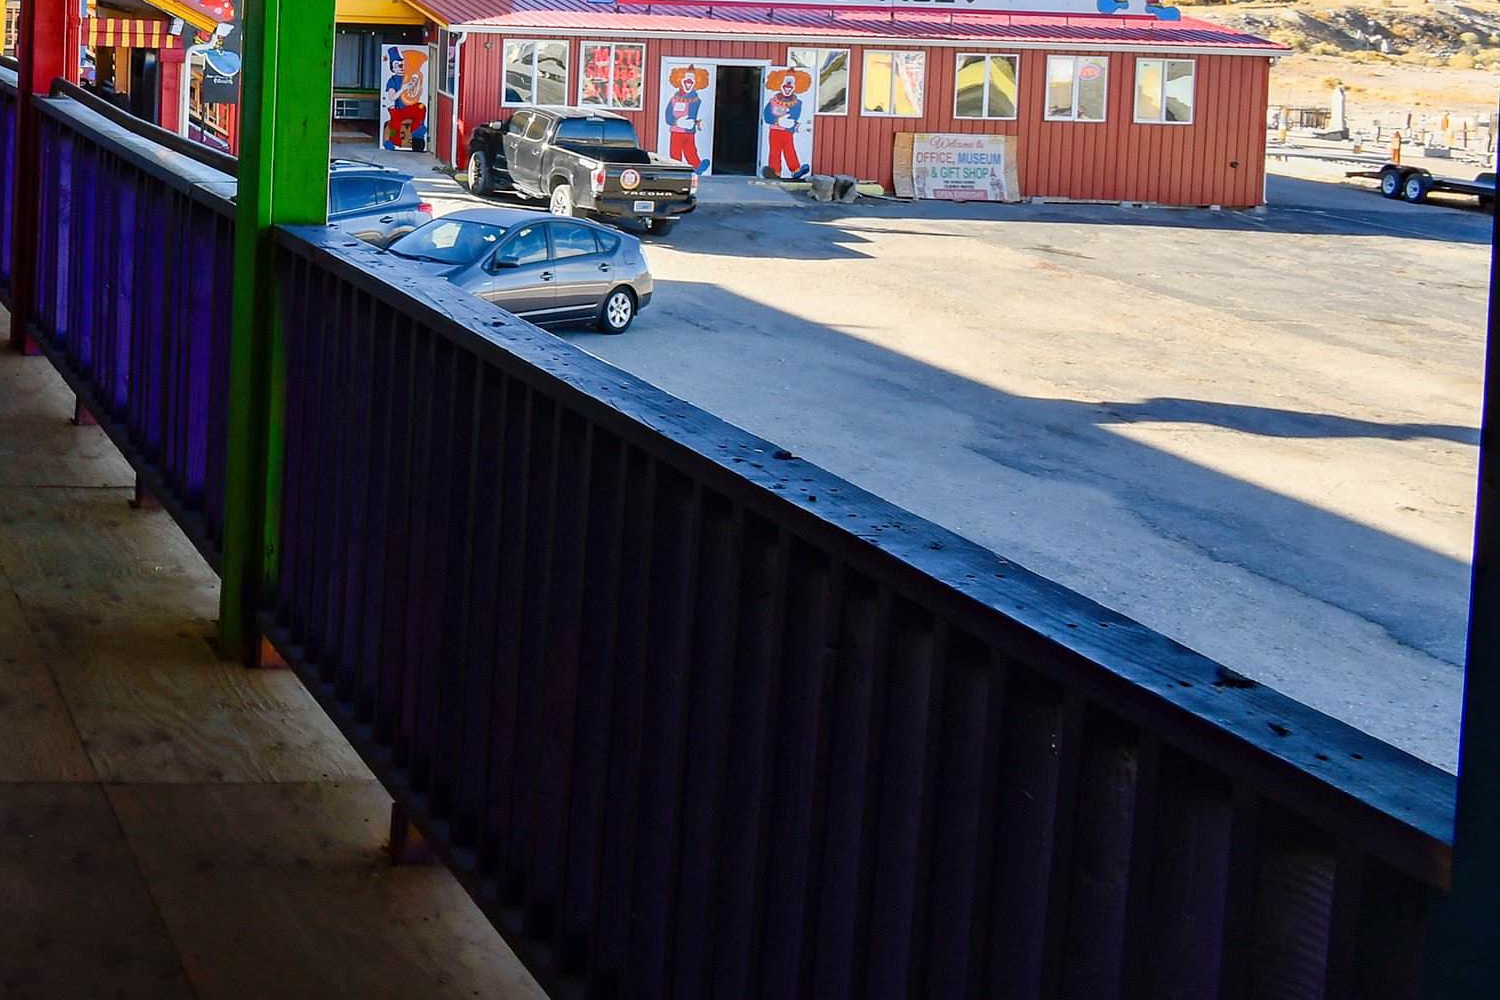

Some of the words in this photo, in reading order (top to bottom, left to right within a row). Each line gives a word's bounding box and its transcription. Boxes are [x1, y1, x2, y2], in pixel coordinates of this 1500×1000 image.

[930, 135, 974, 149] Welcome
[975, 137, 985, 149] to
[916, 152, 955, 165] OFFICE,
[957, 152, 1001, 165] MUSEUM
[931, 167, 938, 178] &
[940, 167, 961, 178] GIFT
[963, 167, 989, 179] SHOP
